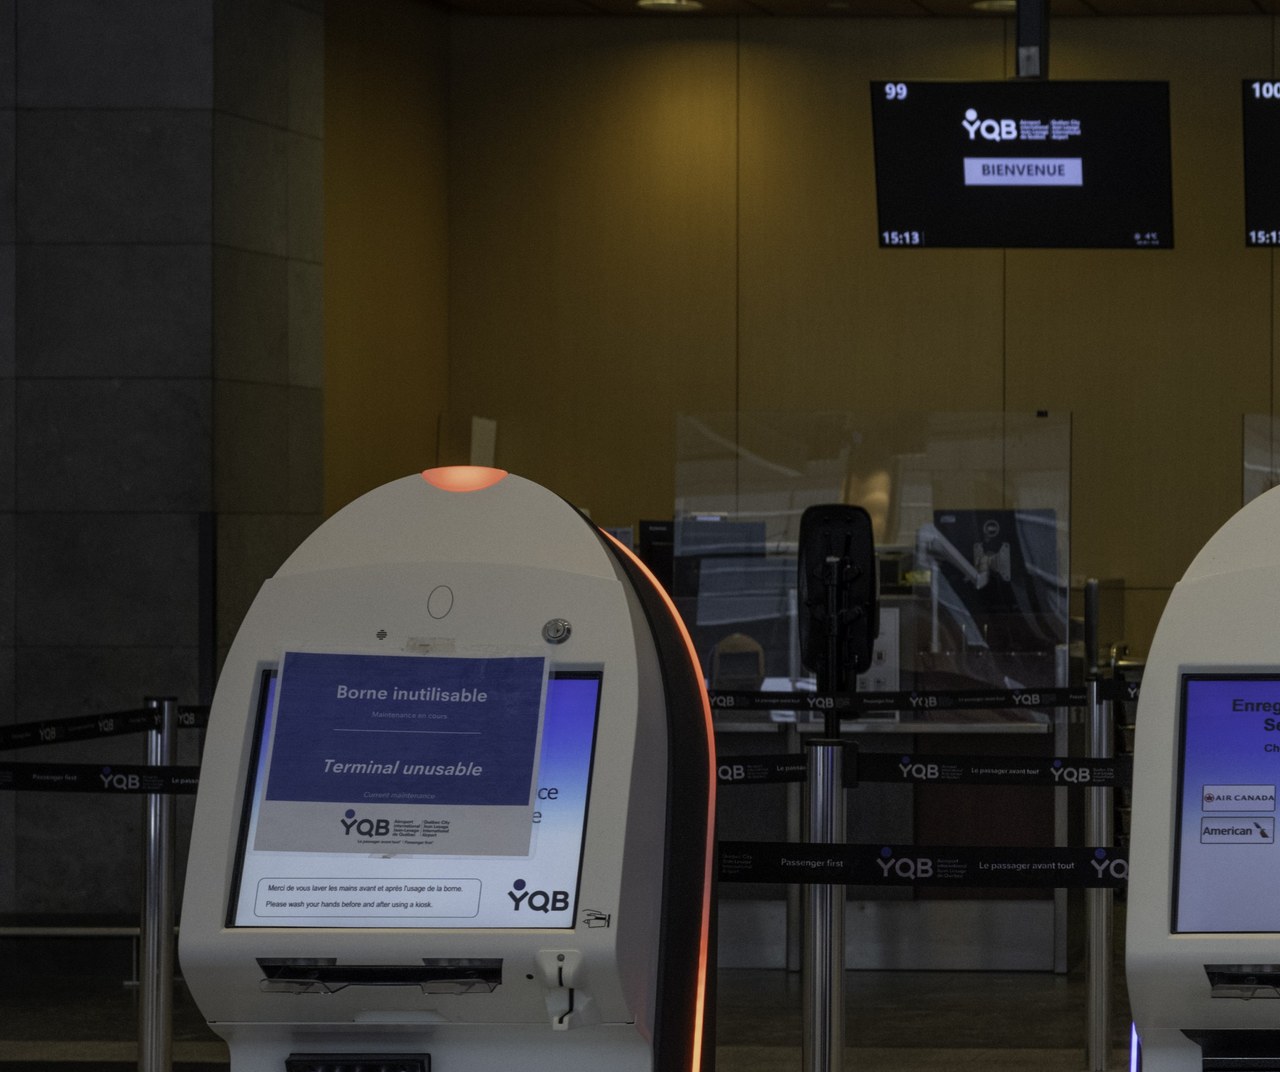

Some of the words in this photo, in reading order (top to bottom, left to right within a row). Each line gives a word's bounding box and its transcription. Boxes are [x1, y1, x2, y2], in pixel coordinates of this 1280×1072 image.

[885, 83, 908, 100] 99
[962, 119, 1017, 141] YQB
[982, 164, 1065, 176] BIENVENUE
[883, 231, 920, 244] 15:13
[336, 685, 388, 700] Borne
[392, 686, 488, 703] inutilisable
[371, 711, 416, 719] Maintenance
[323, 759, 400, 775] Terminal
[402, 761, 483, 777] unusable
[899, 763, 939, 780] YQB
[1050, 767, 1090, 783] YQB
[100, 774, 140, 790] YQB
[340, 818, 390, 838] YQB
[1202, 825, 1253, 836] American
[781, 858, 824, 868] Passenger
[827, 859, 843, 867] first
[876, 858, 933, 879] YQB
[979, 861, 989, 869] Le
[991, 862, 1030, 871] passager
[267, 884, 285, 892] Merci
[311, 884, 327, 892] laver
[329, 884, 338, 892] les
[339, 884, 358, 892] mains
[385, 884, 403, 895] après
[427, 884, 435, 892] de
[436, 884, 443, 892] la
[265, 900, 286, 908] Please
[288, 900, 304, 908] wash
[305, 902, 319, 910] your
[320, 900, 340, 908] hands
[341, 900, 361, 908] before
[362, 900, 374, 908] and
[375, 900, 390, 908] after
[391, 901, 408, 910] using
[415, 901, 433, 909] kiosk.
[508, 890, 569, 914] YQB
